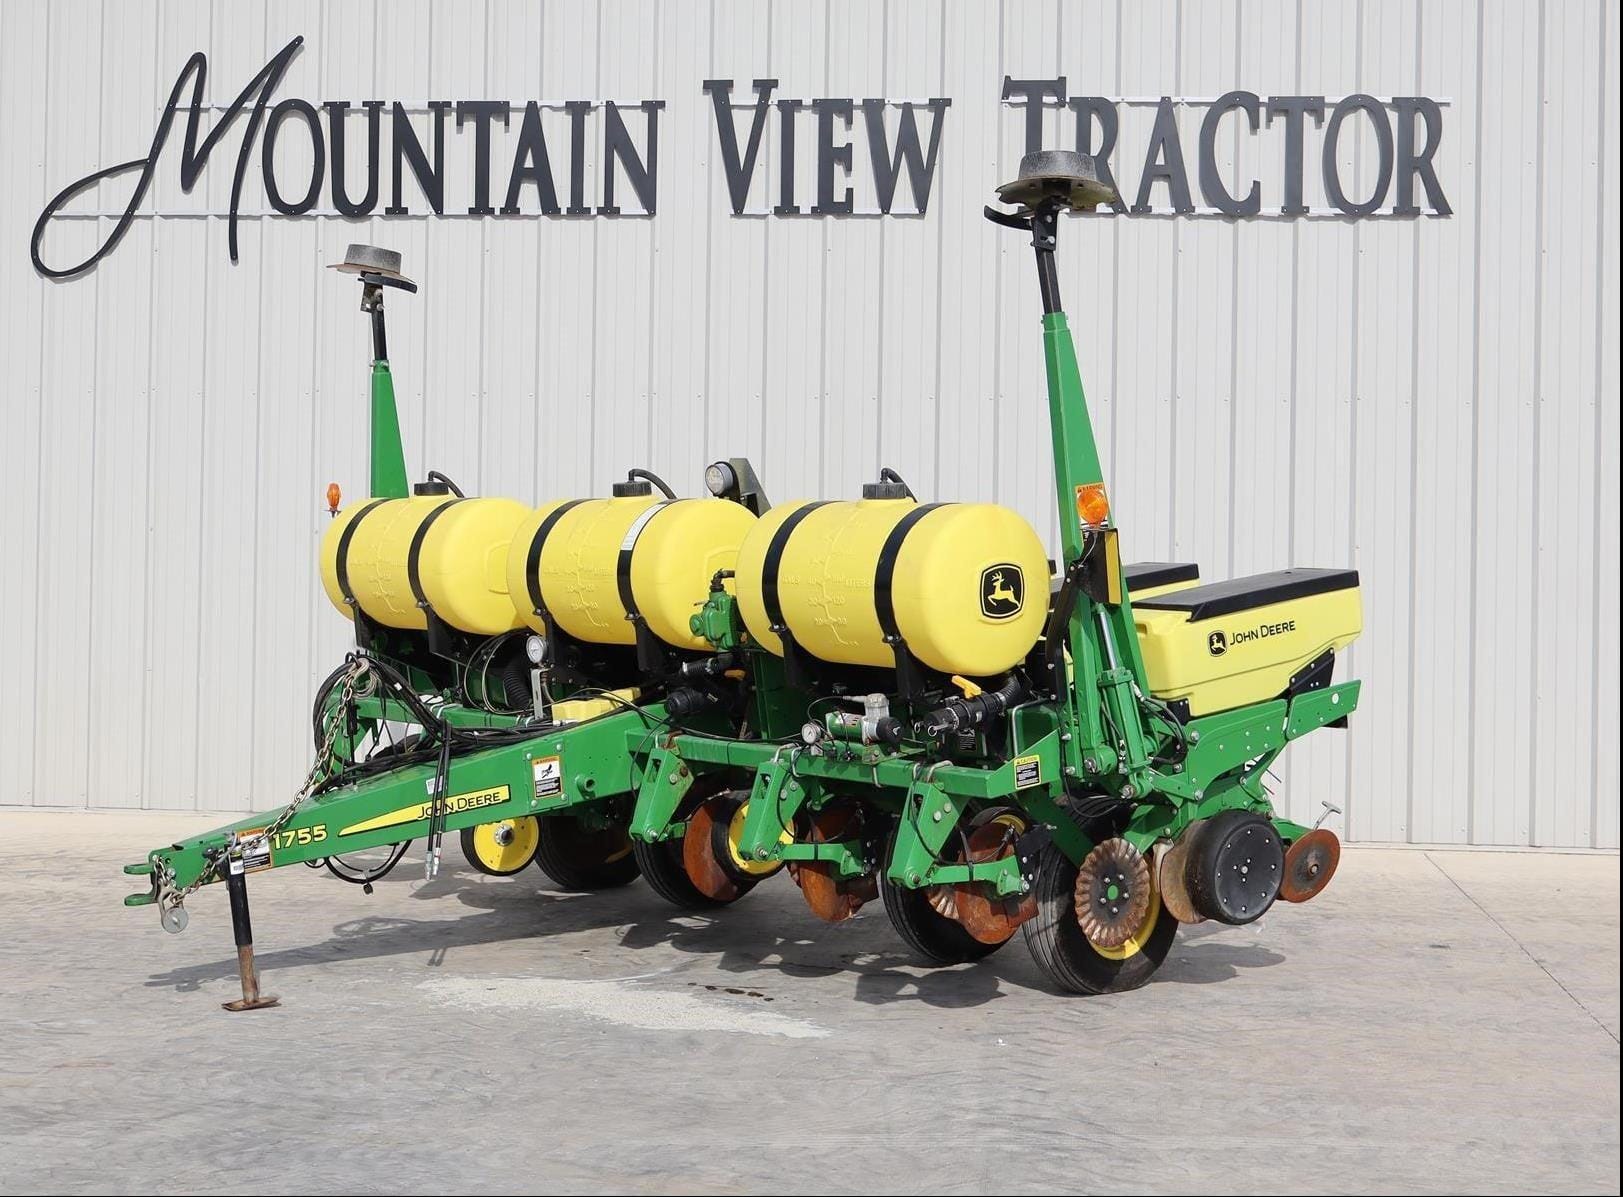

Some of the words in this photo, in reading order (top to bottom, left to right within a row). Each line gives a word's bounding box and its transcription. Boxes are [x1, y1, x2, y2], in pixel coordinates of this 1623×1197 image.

[31, 36, 665, 277] MOUNTAIN
[703, 79, 952, 217] VIEW
[1001, 75, 1454, 218] TRACTOR
[1230, 630, 1259, 645] JOHN
[1260, 620, 1295, 638] DEERE
[457, 791, 501, 810] DEERE
[272, 824, 328, 850] 1755
